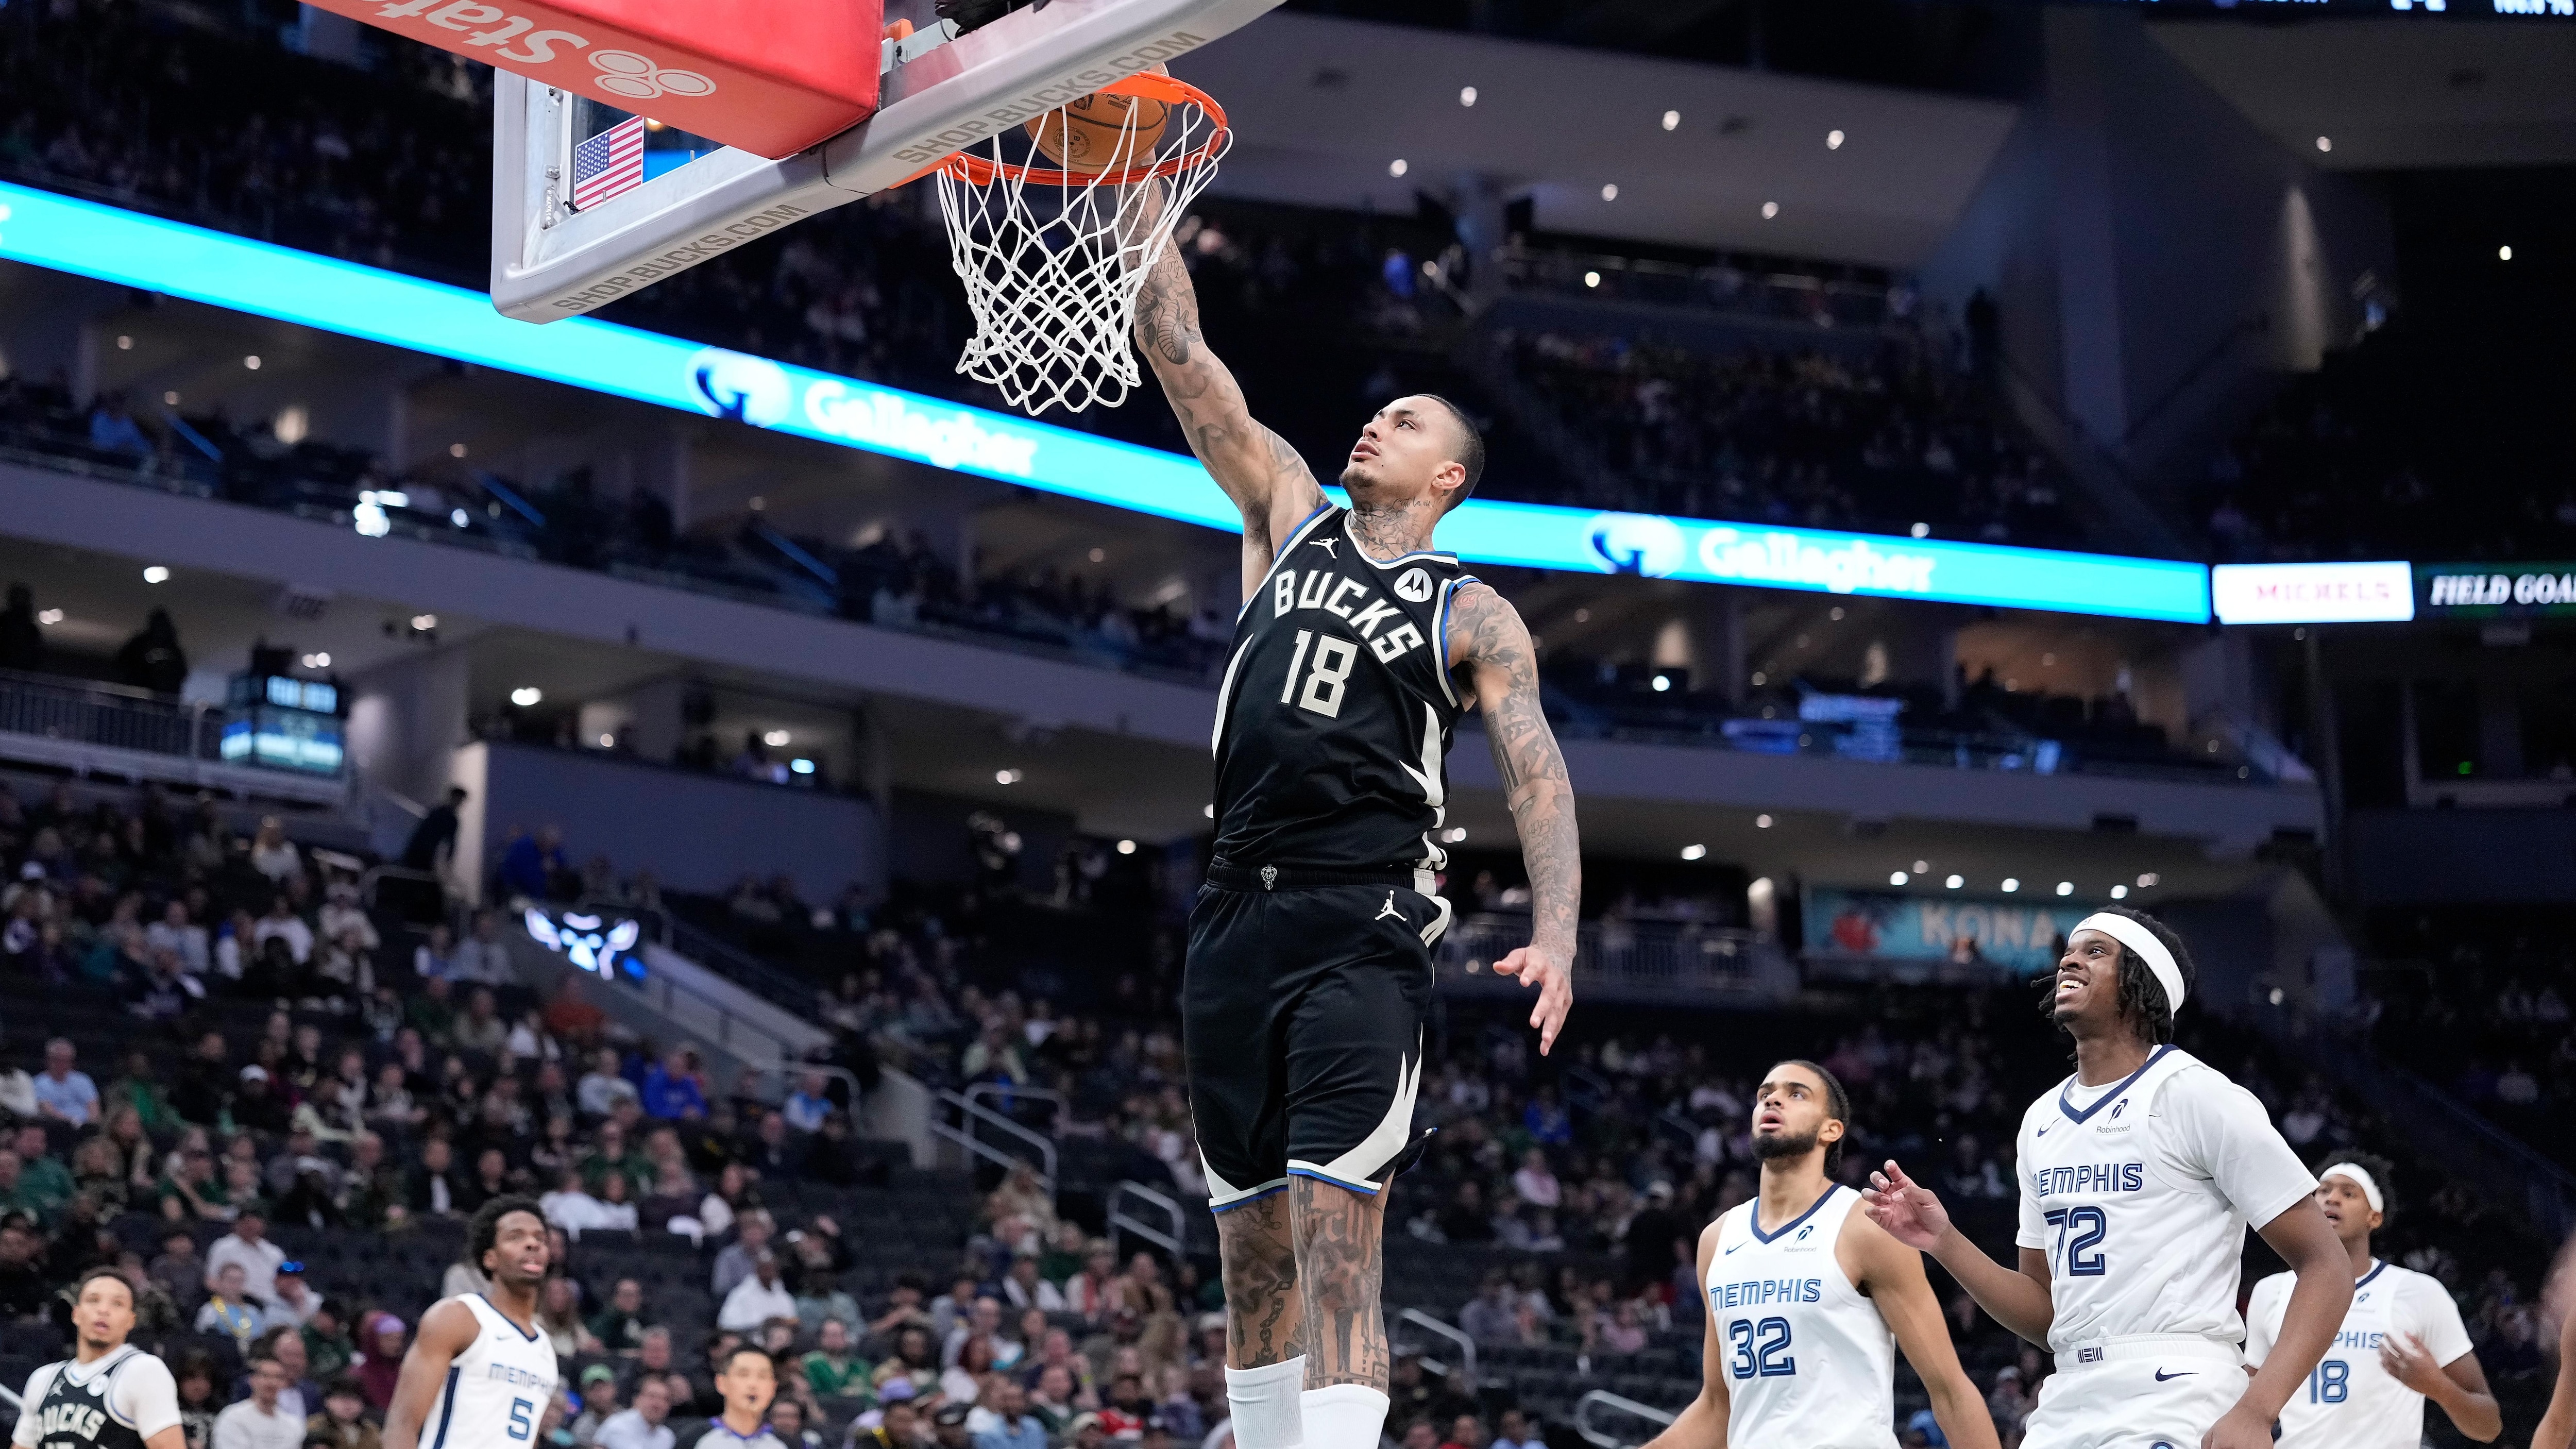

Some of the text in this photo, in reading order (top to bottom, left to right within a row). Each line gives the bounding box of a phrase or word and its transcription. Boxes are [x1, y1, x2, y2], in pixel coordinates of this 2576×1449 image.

[360, 0, 589, 63] Stat
[893, 31, 1207, 164] SHOP.BUCKS.COM
[553, 204, 809, 312] SHOP.BUCKS.COM
[804, 380, 1038, 478] Gallagher
[1699, 528, 1936, 594] Gallagher
[2430, 574, 2512, 605] FIELD
[1274, 568, 1425, 664] BUCKS
[1279, 627, 1361, 721] 18
[1921, 902, 2057, 950] KONA
[2096, 1124, 2130, 1133] Robinhood
[2043, 1206, 2107, 1281] 72
[1710, 1279, 1821, 1313] MEMPHIS
[1730, 1317, 1796, 1379] 32
[2309, 1360, 2349, 1405] 18
[507, 1397, 534, 1441] 5
